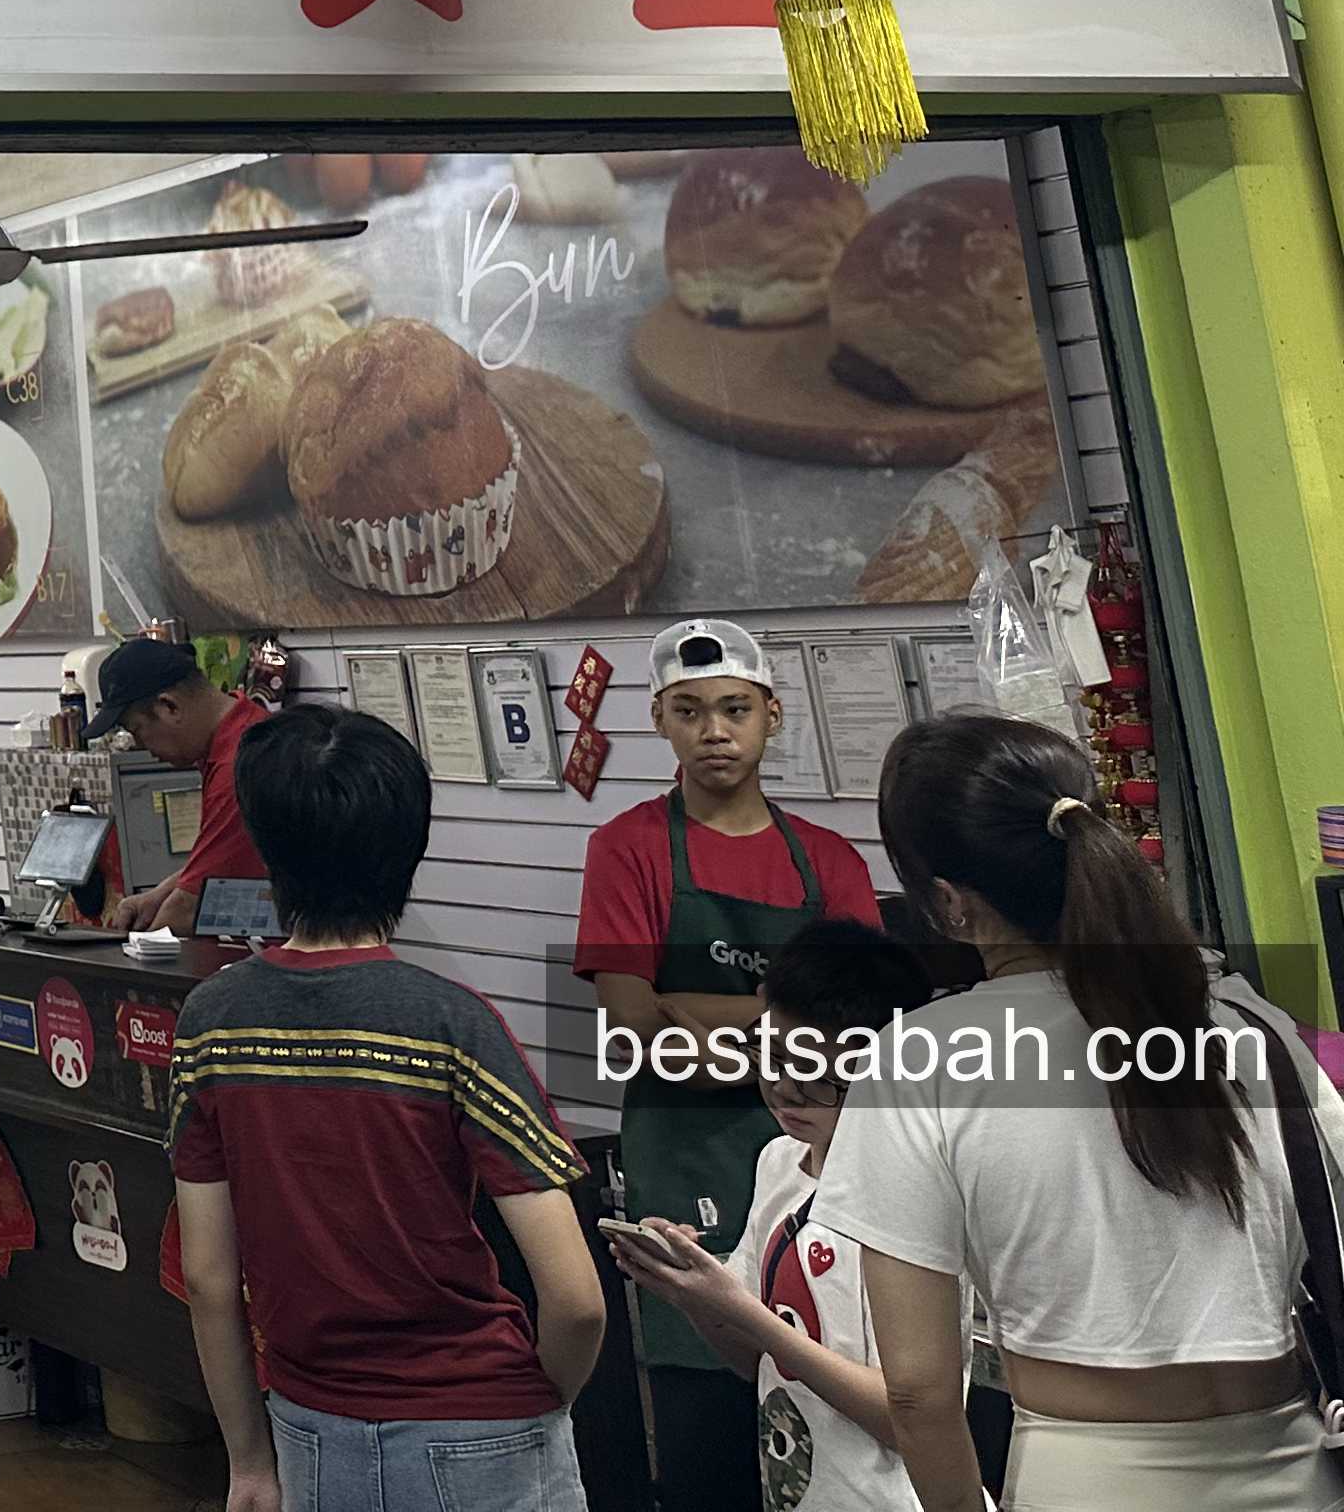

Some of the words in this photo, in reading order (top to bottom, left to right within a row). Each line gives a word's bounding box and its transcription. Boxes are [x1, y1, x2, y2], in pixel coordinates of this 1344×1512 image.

[456, 182, 636, 371] Bun
[6, 372, 40, 405] C38
[37, 571, 67, 604] B17
[501, 703, 531, 744] B
[709, 940, 770, 976] Grab
